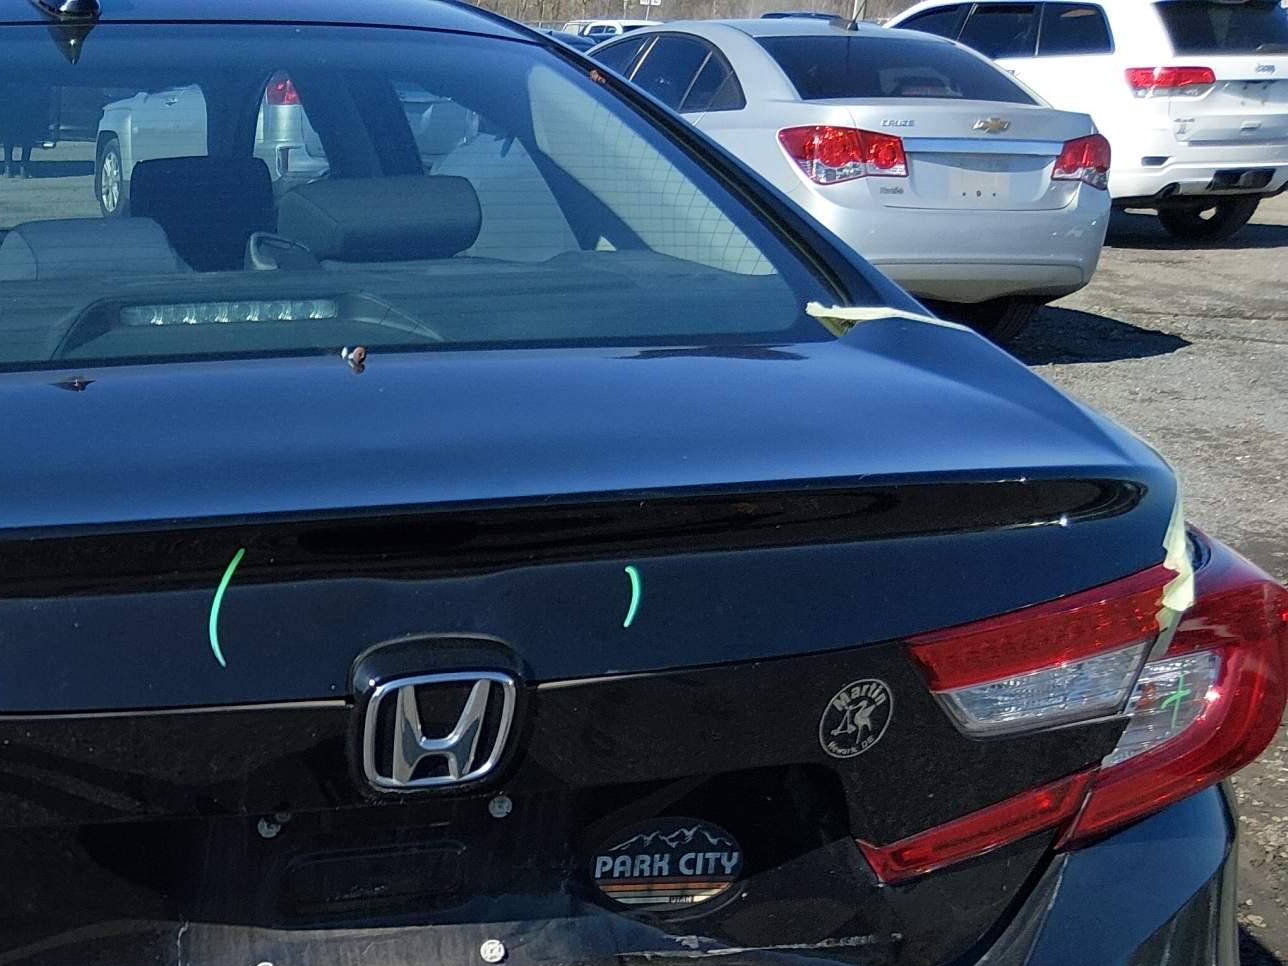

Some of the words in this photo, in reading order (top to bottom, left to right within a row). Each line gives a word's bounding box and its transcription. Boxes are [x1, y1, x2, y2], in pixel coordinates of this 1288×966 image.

[833, 683, 886, 711] Martin
[594, 853, 670, 878] PARK
[679, 852, 739, 875] CITY
